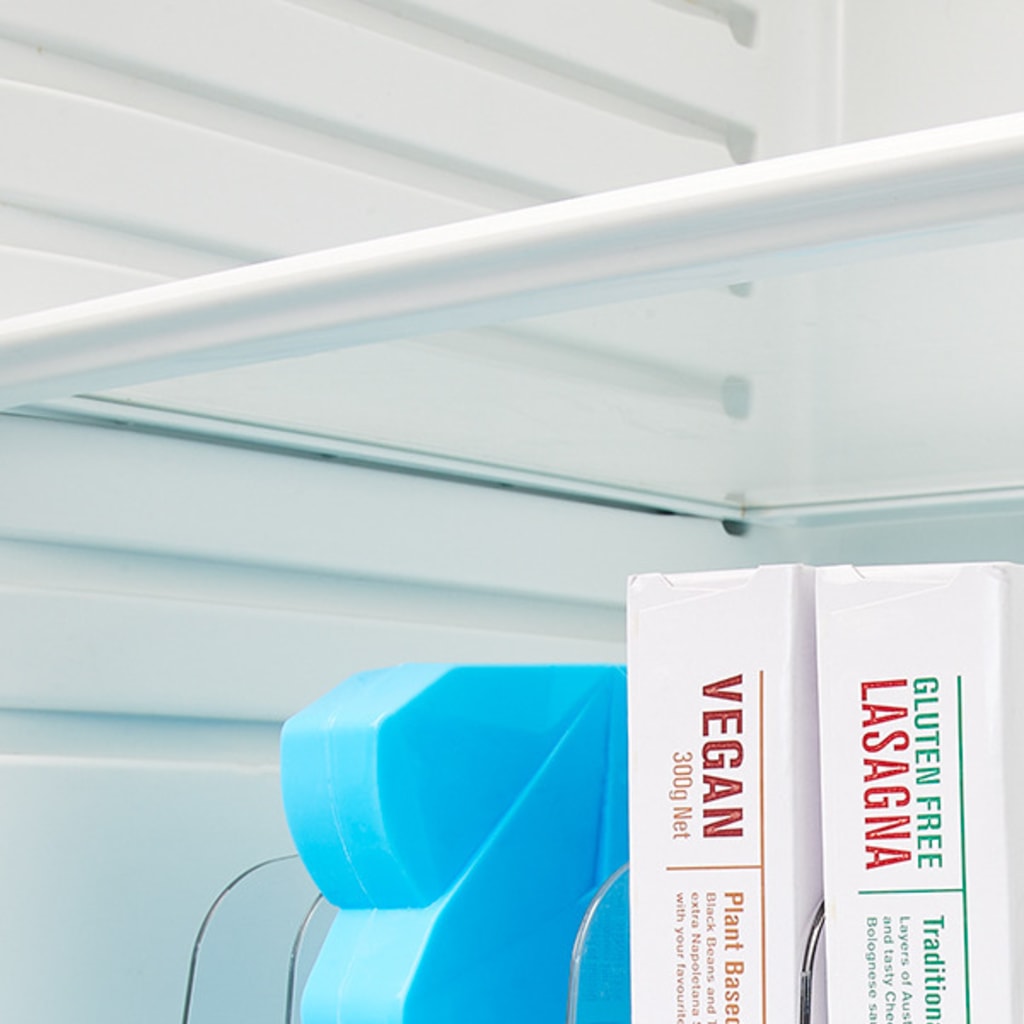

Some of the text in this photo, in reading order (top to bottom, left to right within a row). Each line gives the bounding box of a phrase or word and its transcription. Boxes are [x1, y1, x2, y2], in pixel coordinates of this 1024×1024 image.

[702, 673, 744, 839] VEGAN
[861, 678, 912, 870] LASAGNA
[913, 677, 943, 869] GLUTEN FREE
[669, 751, 693, 840] 300g Net
[676, 892, 686, 922] with
[691, 892, 702, 929] extra
[706, 891, 717, 932] Black
[724, 891, 744, 951] Plant
[883, 915, 894, 944] and
[674, 927, 686, 959] your
[706, 937, 717, 983] Beans
[865, 916, 879, 999] Bolognese
[897, 915, 912, 966] Layers
[690, 933, 702, 1016] Napoletana
[882, 949, 895, 986] tasty
[900, 971, 912, 986] of
[706, 987, 717, 1014] and
